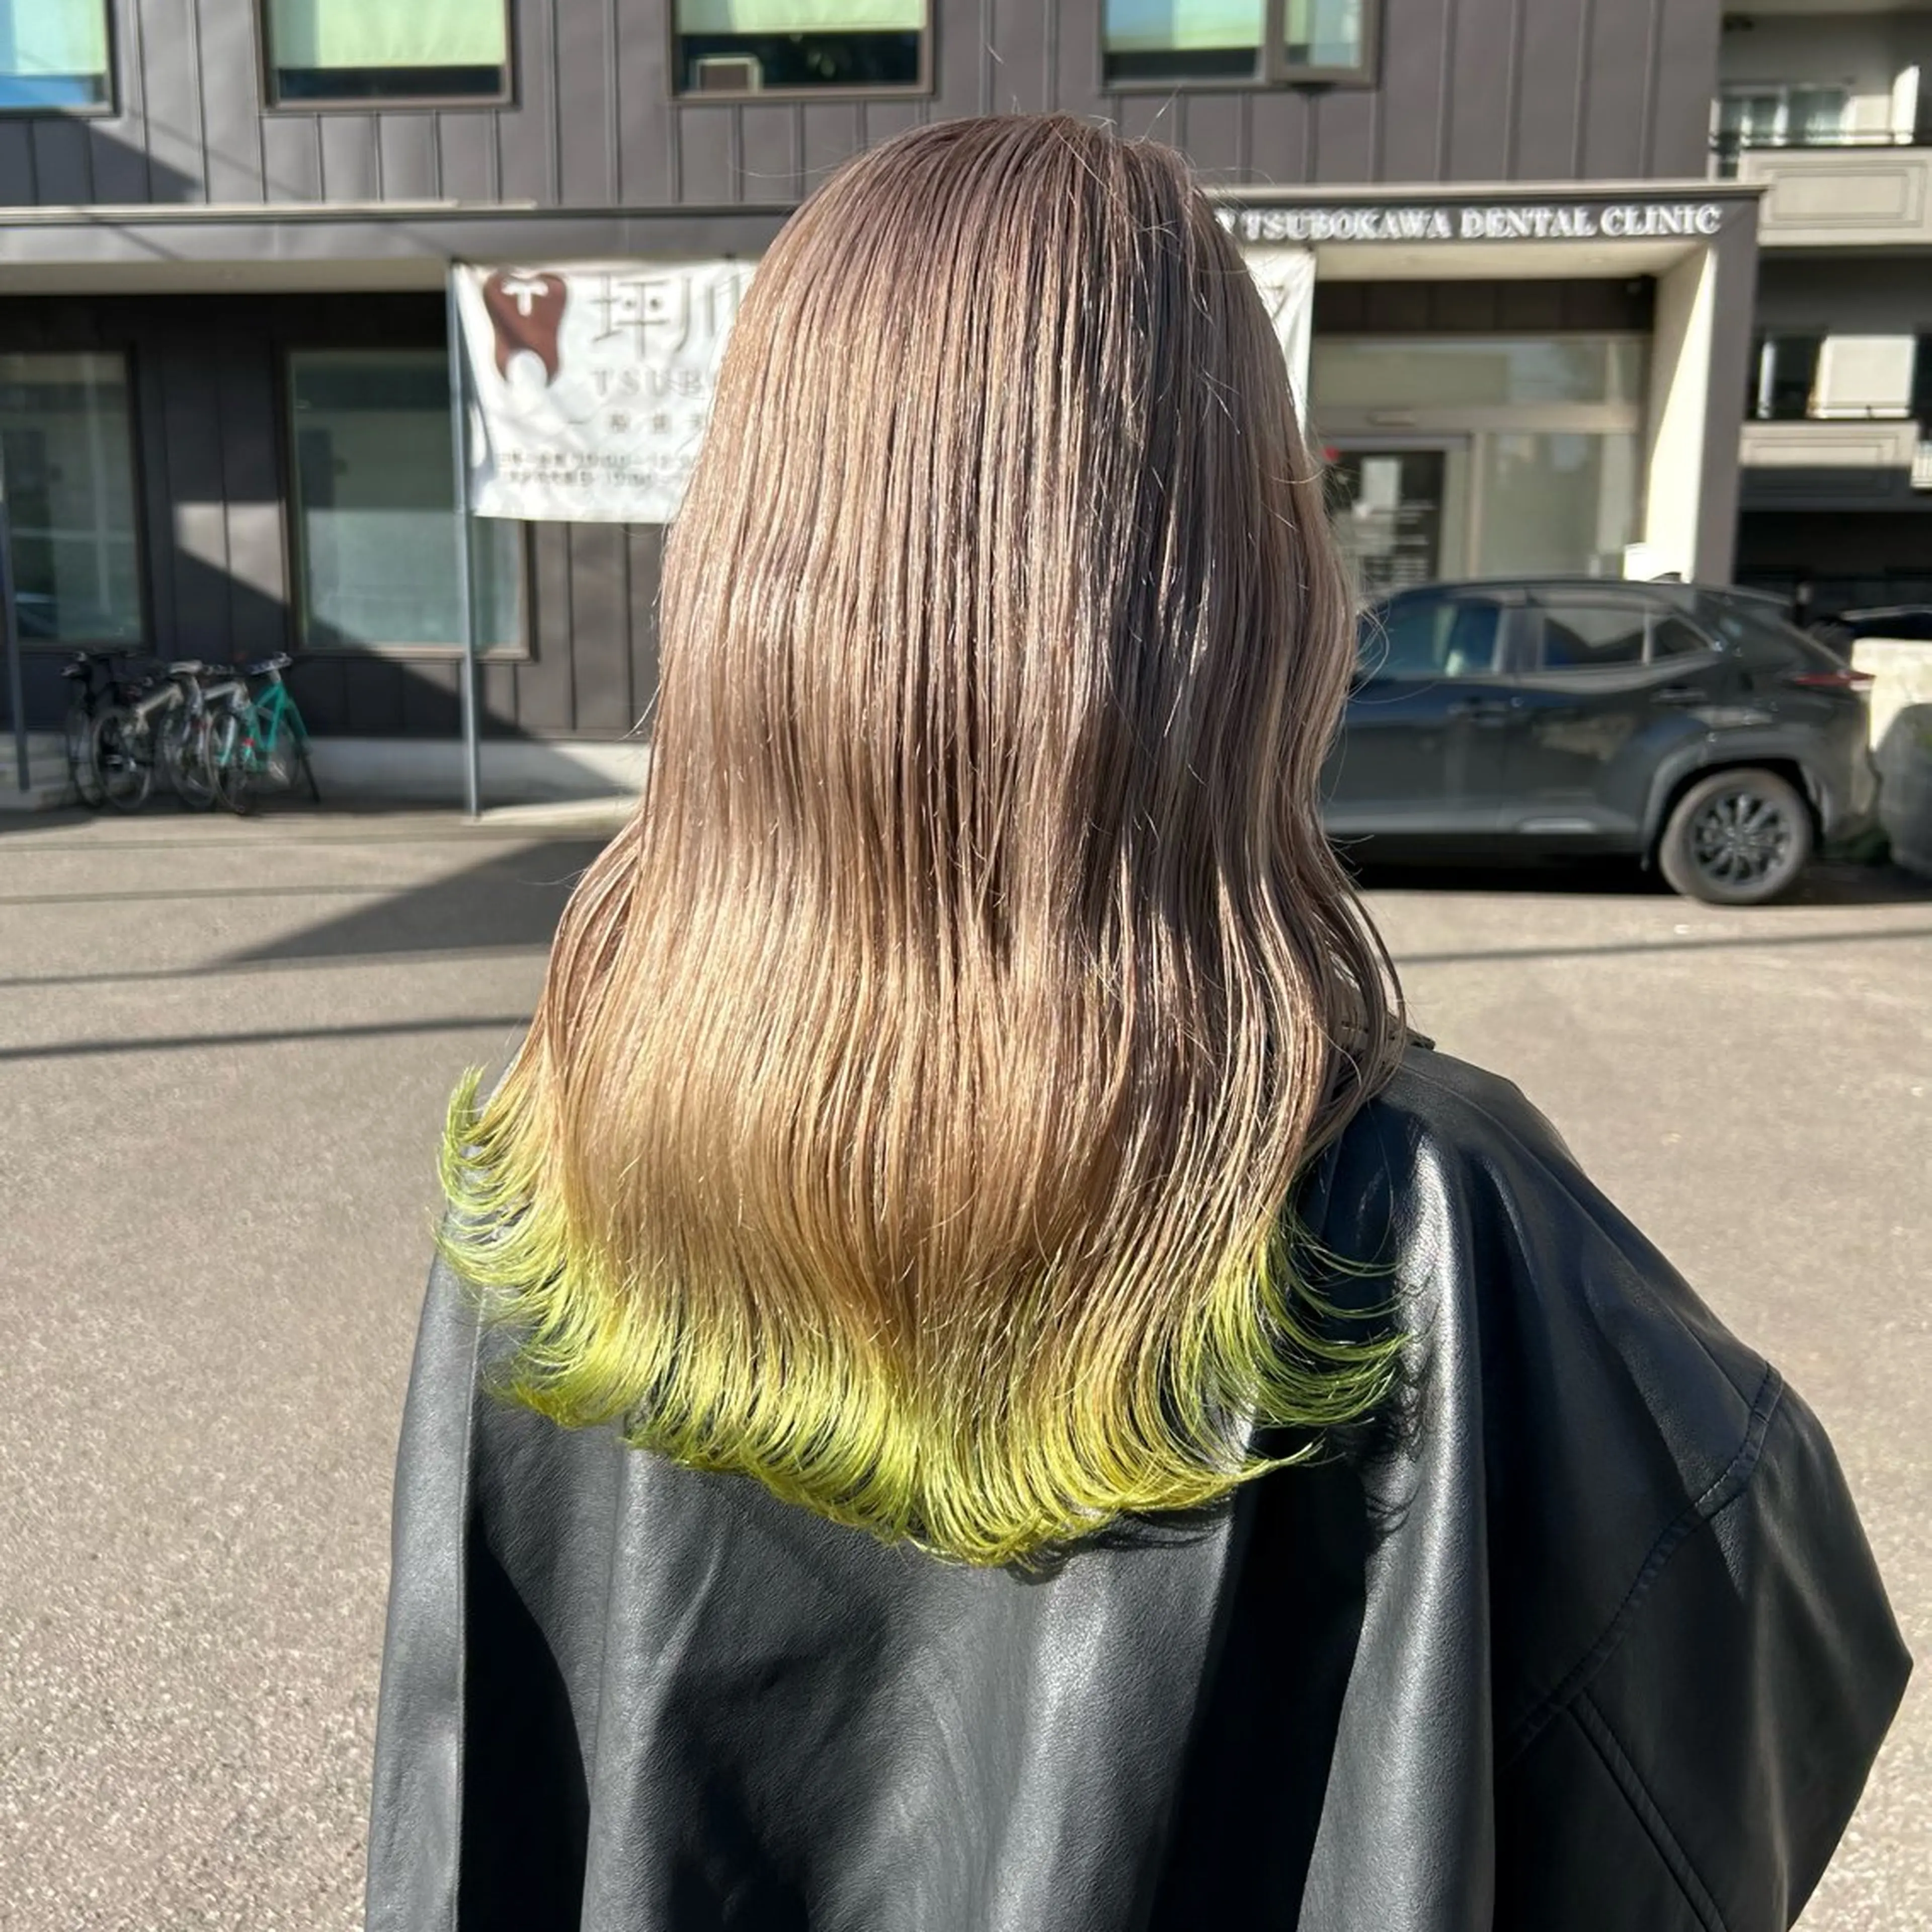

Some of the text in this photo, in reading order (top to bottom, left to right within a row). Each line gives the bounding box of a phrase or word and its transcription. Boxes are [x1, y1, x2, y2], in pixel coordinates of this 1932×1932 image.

[1242, 203, 1722, 240] TSUBOKAWA DENTAL CLINIC
